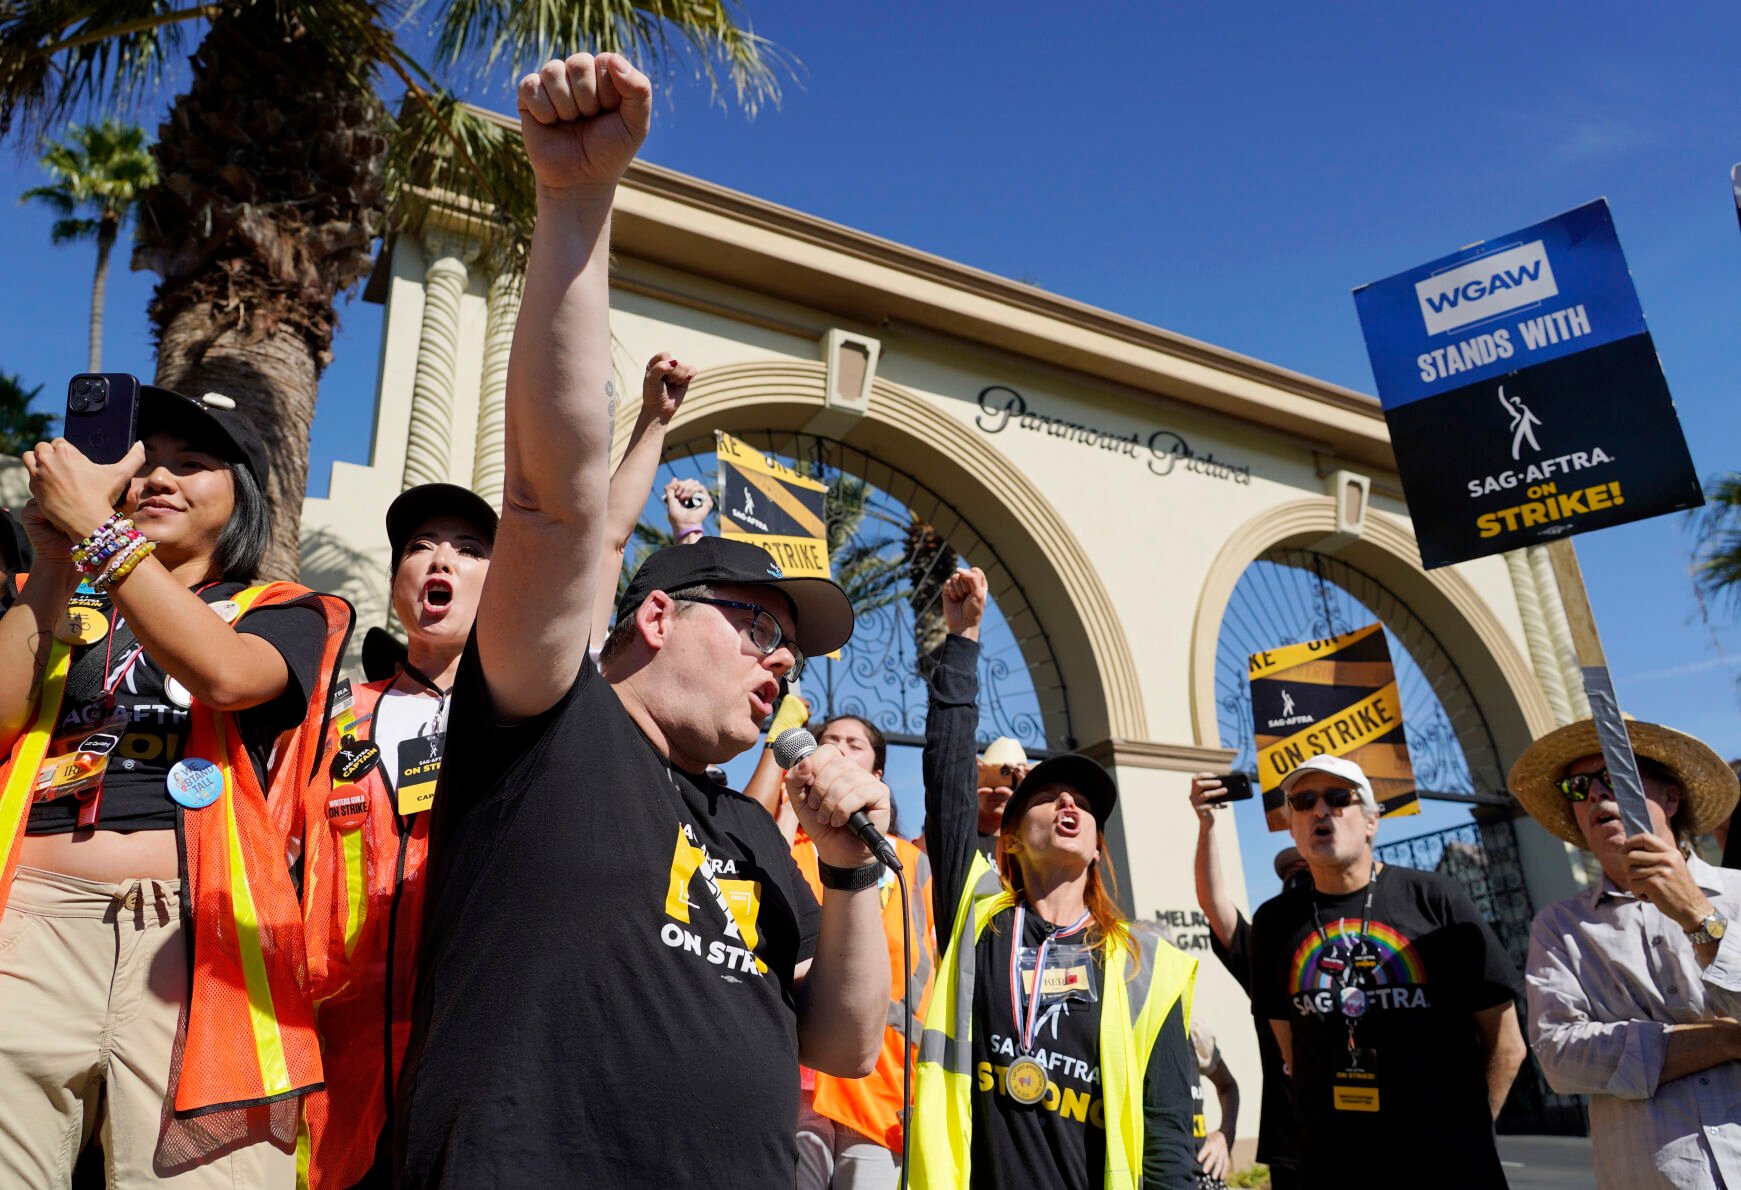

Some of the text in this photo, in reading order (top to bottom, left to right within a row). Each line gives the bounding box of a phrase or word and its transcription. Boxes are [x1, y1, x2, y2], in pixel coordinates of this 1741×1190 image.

[1425, 259, 1542, 314] WGAW
[1416, 303, 1593, 384] STANDS WITH
[975, 385, 1251, 486] Paramount Pictures
[1475, 480, 1626, 539] STRIKE!
[1526, 481, 1558, 500] ON
[1269, 696, 1395, 776] ON STRIKE
[183, 766, 215, 787] STAND
[342, 746, 379, 779] CAPTAIN
[403, 766, 421, 777] ON
[191, 777, 215, 794] TALL
[328, 801, 368, 819] ON STRIKE
[660, 922, 764, 979] ON STR
